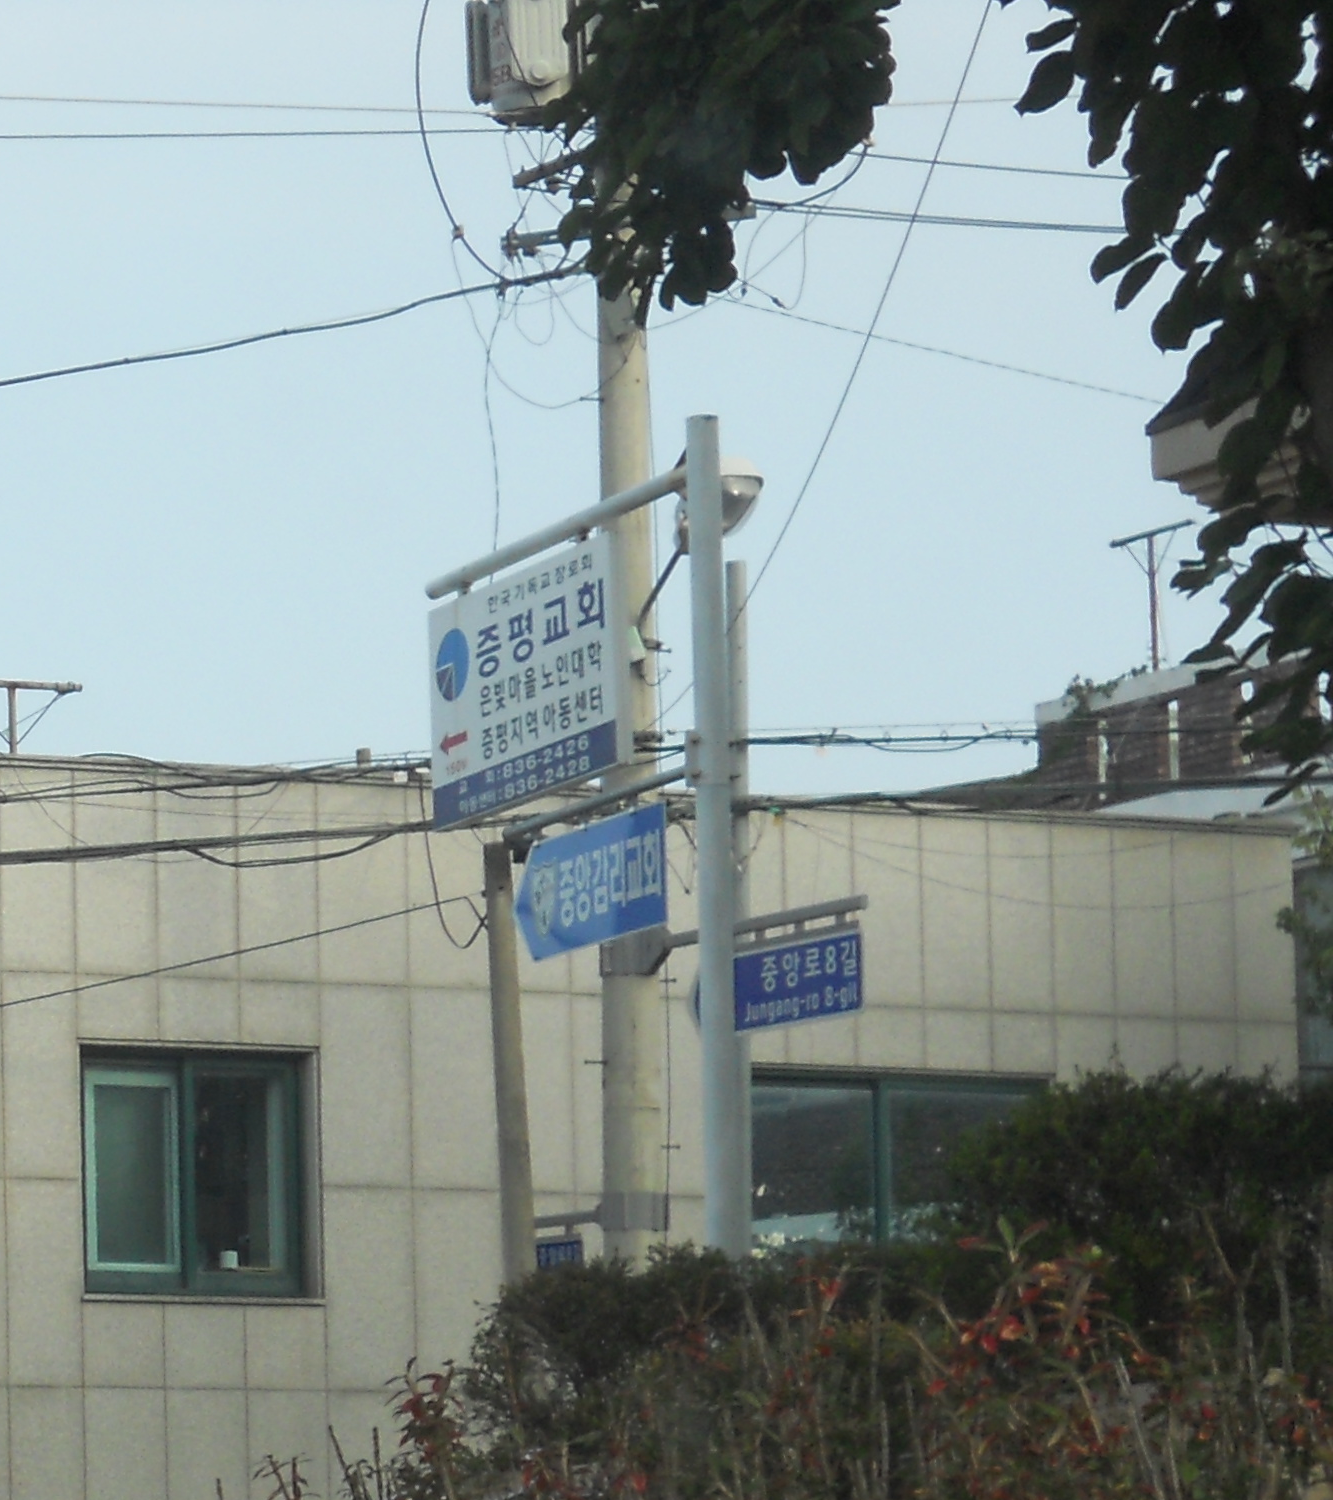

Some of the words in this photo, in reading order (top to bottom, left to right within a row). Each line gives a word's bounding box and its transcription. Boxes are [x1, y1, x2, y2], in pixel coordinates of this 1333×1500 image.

[475, 577, 605, 678] 증평교회
[559, 828, 662, 928] 중앙감리교회
[744, 993, 820, 1023] Jungang-ro
[824, 981, 858, 1009] 8-gil
[760, 940, 858, 992] 중앙로8길
